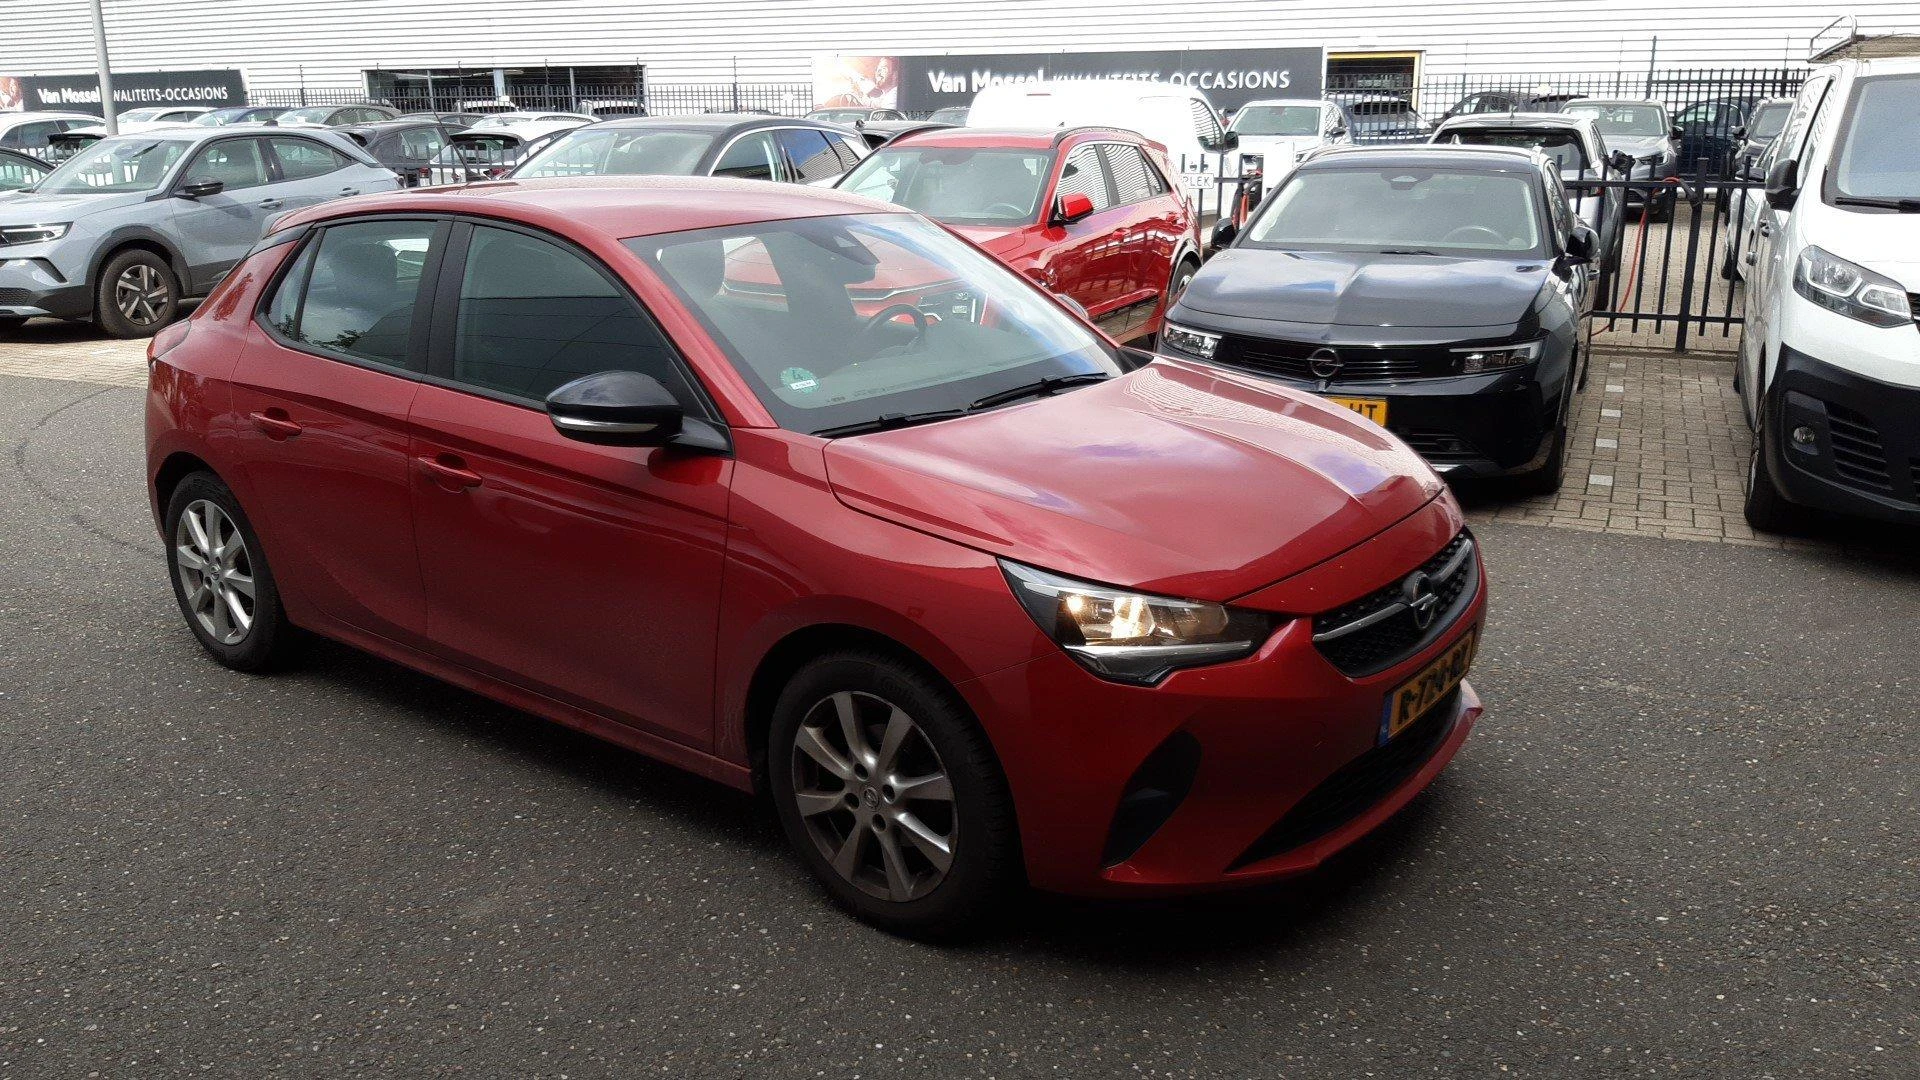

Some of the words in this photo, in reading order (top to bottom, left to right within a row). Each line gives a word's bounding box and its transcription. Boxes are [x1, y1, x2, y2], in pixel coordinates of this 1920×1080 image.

[928, 71, 966, 92] Van
[37, 88, 60, 104] Van
[61, 86, 101, 104] Mossel
[113, 86, 229, 102] WALITEITS-OCCASIONS
